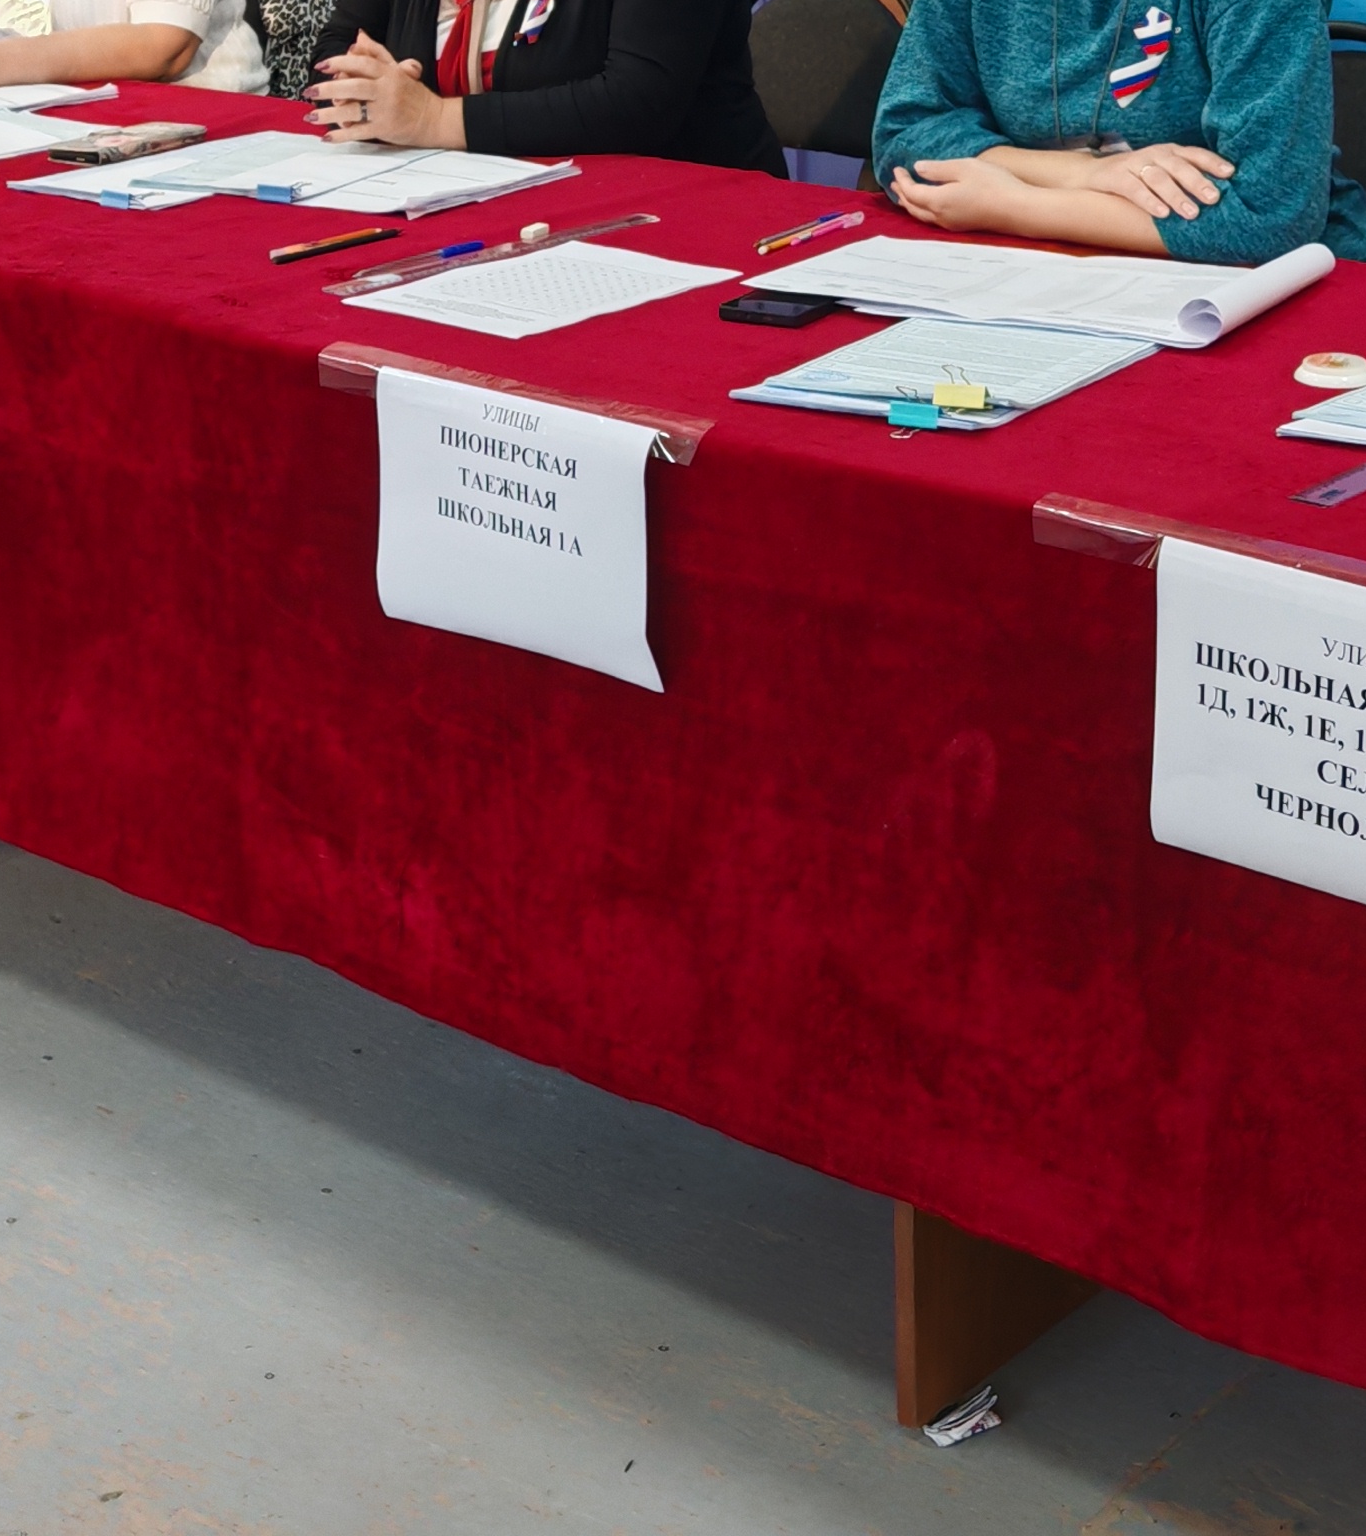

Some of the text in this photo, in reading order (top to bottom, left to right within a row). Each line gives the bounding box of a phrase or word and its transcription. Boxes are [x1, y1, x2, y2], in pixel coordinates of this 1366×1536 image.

[482, 403, 541, 432] УЛИЦЫ
[439, 425, 578, 480] ПИОНЕРСКАЯ
[458, 466, 558, 512] ТАЕЖНАЯ
[437, 496, 583, 558] ШКОЛЬНАЯ 1А
[1196, 683, 1237, 719] 1Д,
[1246, 697, 1295, 737] 1Ж,
[1304, 714, 1345, 752] 1Е,
